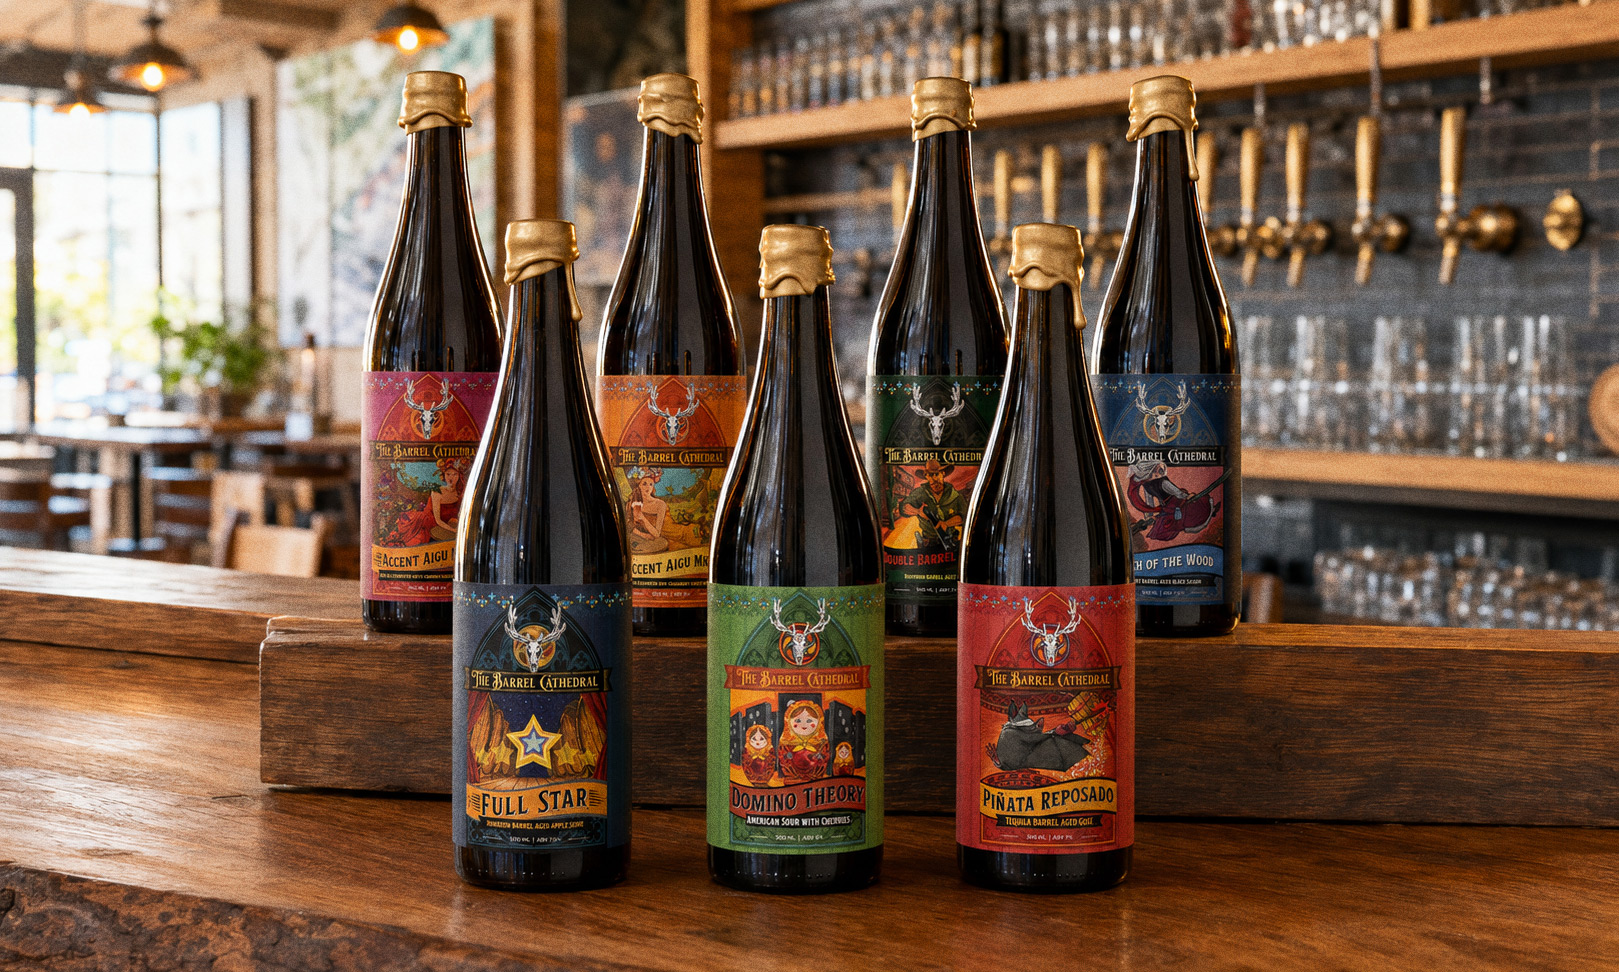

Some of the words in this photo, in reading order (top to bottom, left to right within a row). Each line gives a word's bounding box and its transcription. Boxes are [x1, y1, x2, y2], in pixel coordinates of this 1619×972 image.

[393, 443, 430, 460] BARREL
[433, 444, 476, 459] CATHEDRA
[618, 449, 635, 464] THE
[638, 449, 676, 465] BARREL
[679, 451, 724, 466] CATHEDRAL
[885, 447, 901, 463] THE
[902, 448, 940, 463] BARREL
[943, 449, 982, 464] CATHEDR
[1110, 448, 1125, 462] THE
[1127, 448, 1165, 463] BARREL
[1168, 449, 1217, 464] CATHEDRAL
[383, 553, 420, 568] ACCENT
[423, 550, 448, 565] AIGU
[631, 562, 662, 575] CCENT
[666, 556, 691, 572] AIGU
[918, 552, 957, 566] BARREL
[1146, 559, 1158, 570] OF
[1162, 556, 1182, 568] THE
[1186, 553, 1214, 567] WOOD
[471, 670, 490, 687] THE
[492, 672, 535, 691] BARREL
[540, 675, 598, 692] CATHEDRAL
[736, 669, 757, 686] THE
[759, 670, 804, 688] BARREL
[807, 672, 860, 689] CATHEDRAL
[987, 669, 1007, 686] THE
[1010, 671, 1054, 688] BARREL
[1057, 672, 1110, 688] CATHEDRAL
[482, 793, 529, 816] FULL
[538, 788, 588, 813] STAR
[732, 787, 797, 812] DOMINO
[803, 784, 864, 809] THEORY
[983, 788, 1035, 812] PIÑATA
[1041, 786, 1114, 811] REPOSADO
[746, 815, 780, 826] AMERICAN
[781, 817, 800, 826] SOUR
[801, 818, 820, 826] WITH
[1005, 816, 1031, 827] TEQUILA
[1032, 818, 1059, 827] BARREL
[1060, 818, 1078, 827] AGED
